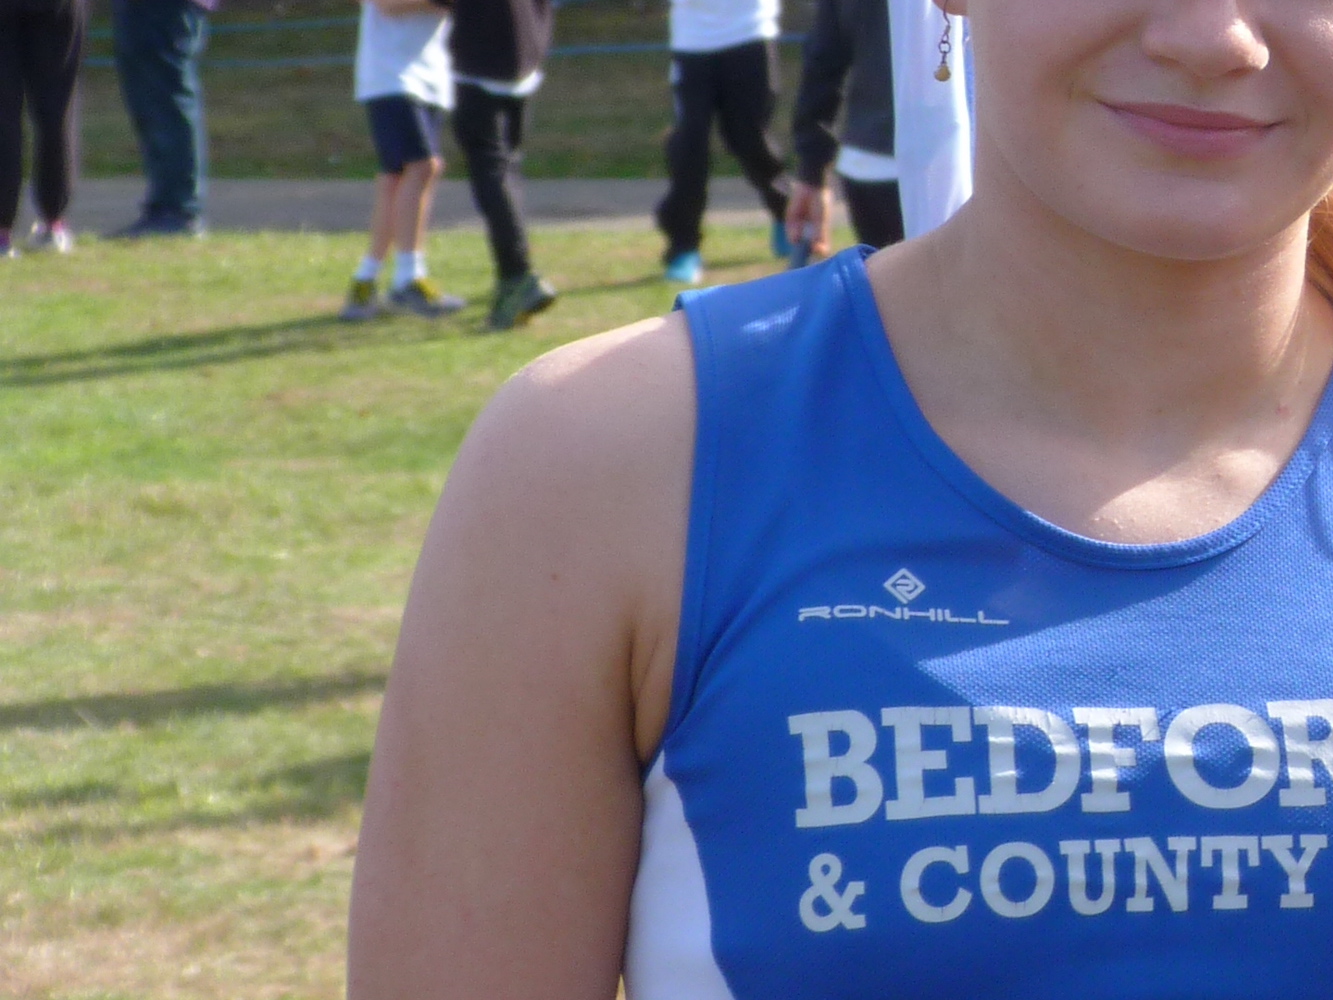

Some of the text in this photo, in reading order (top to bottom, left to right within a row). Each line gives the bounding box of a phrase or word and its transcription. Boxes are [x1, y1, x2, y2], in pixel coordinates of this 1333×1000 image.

[798, 604, 1009, 625] RONHILL
[798, 853, 866, 932] &
[900, 834, 1327, 924] COUNTY
